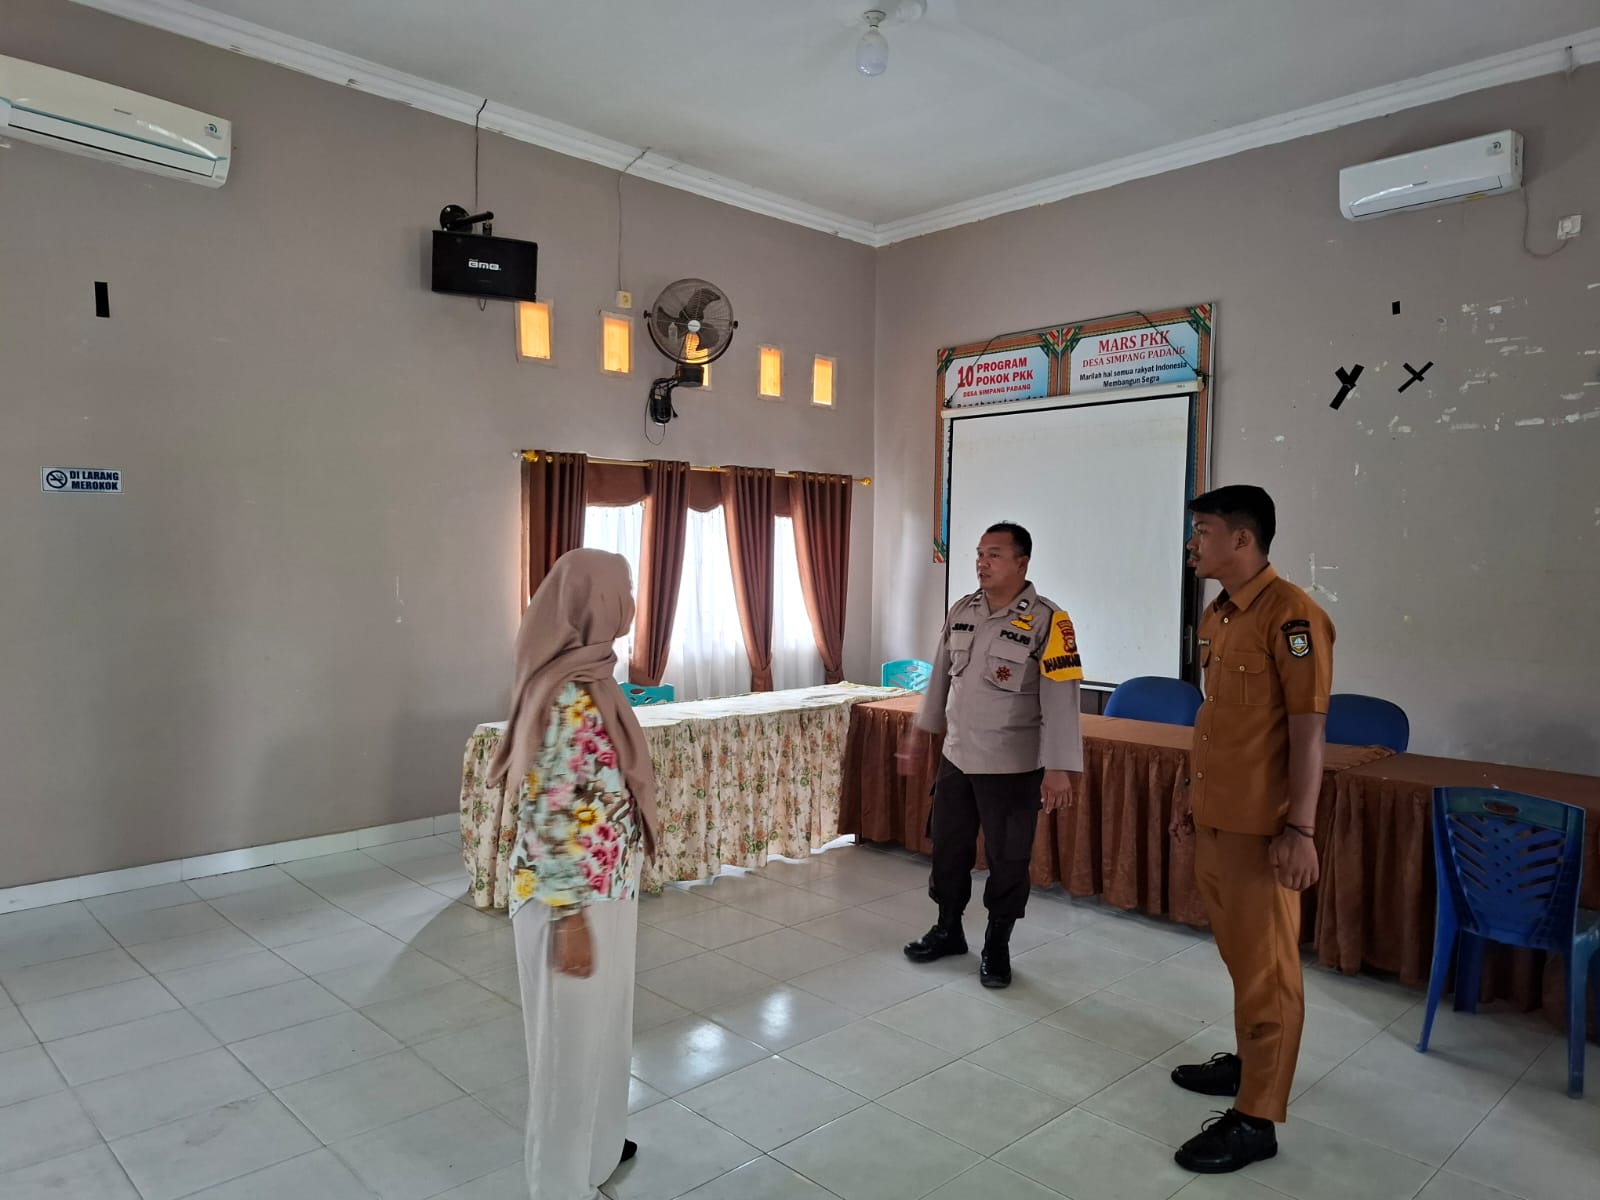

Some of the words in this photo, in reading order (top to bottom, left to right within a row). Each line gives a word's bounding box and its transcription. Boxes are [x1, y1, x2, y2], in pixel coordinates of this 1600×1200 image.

[1098, 335, 1137, 353] MARS
[1140, 330, 1170, 347] PKK
[976, 357, 1028, 373] PROGRAM
[1082, 357, 1104, 368] DESA
[1106, 351, 1146, 365] SIMPANG
[1148, 346, 1185, 359] PADANG
[957, 365, 975, 388] 10
[976, 372, 1010, 386] POKOK
[1012, 369, 1034, 382] PKK
[1079, 371, 1102, 381] Marilah
[1113, 368, 1134, 377] semua
[1134, 365, 1154, 376] rakyat
[1155, 361, 1187, 371] Indonesia
[1103, 377, 1141, 387] Membangun
[1141, 376, 1160, 384] Segra
[963, 390, 977, 398] DESA
[979, 387, 1005, 396] SIMPANG
[1006, 383, 1031, 392] PADANG
[69, 470, 80, 480] DI
[82, 471, 119, 481] LARANG
[71, 481, 118, 490] MEROKOK
[1000, 630, 1031, 645] POLRI
